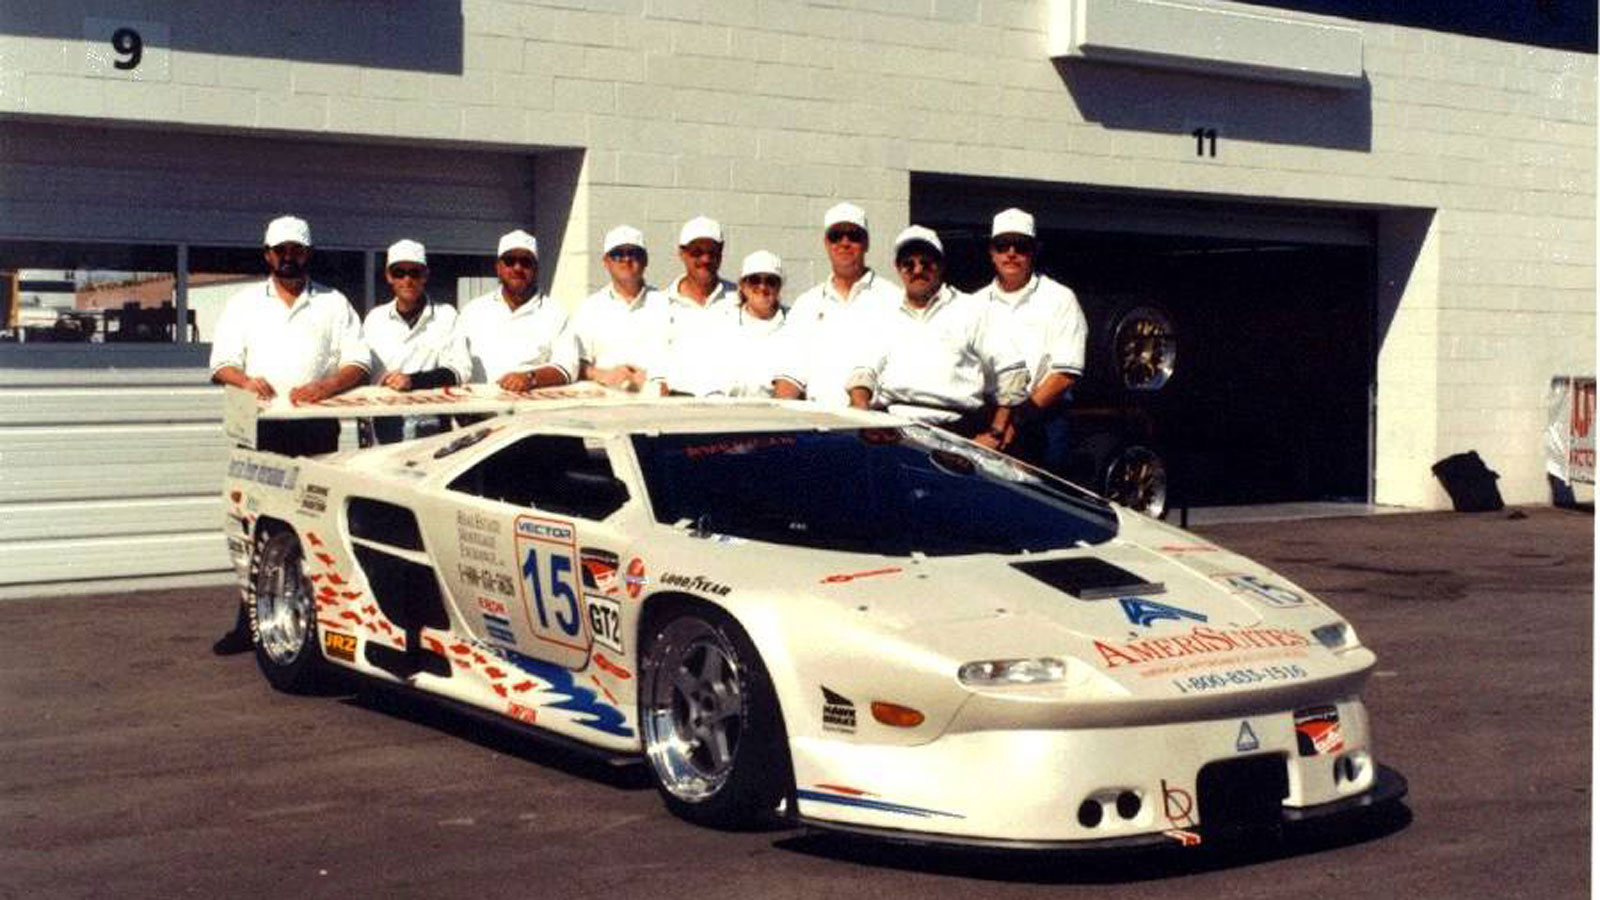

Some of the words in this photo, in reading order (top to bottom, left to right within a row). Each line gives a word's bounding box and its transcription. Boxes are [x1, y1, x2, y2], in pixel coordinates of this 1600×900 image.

[111, 28, 143, 70] 9
[1192, 127, 1217, 156] 11
[519, 522, 571, 539] VECTOR
[522, 547, 580, 637] 15
[588, 602, 620, 645] GT2
[325, 632, 356, 652] JRZ
